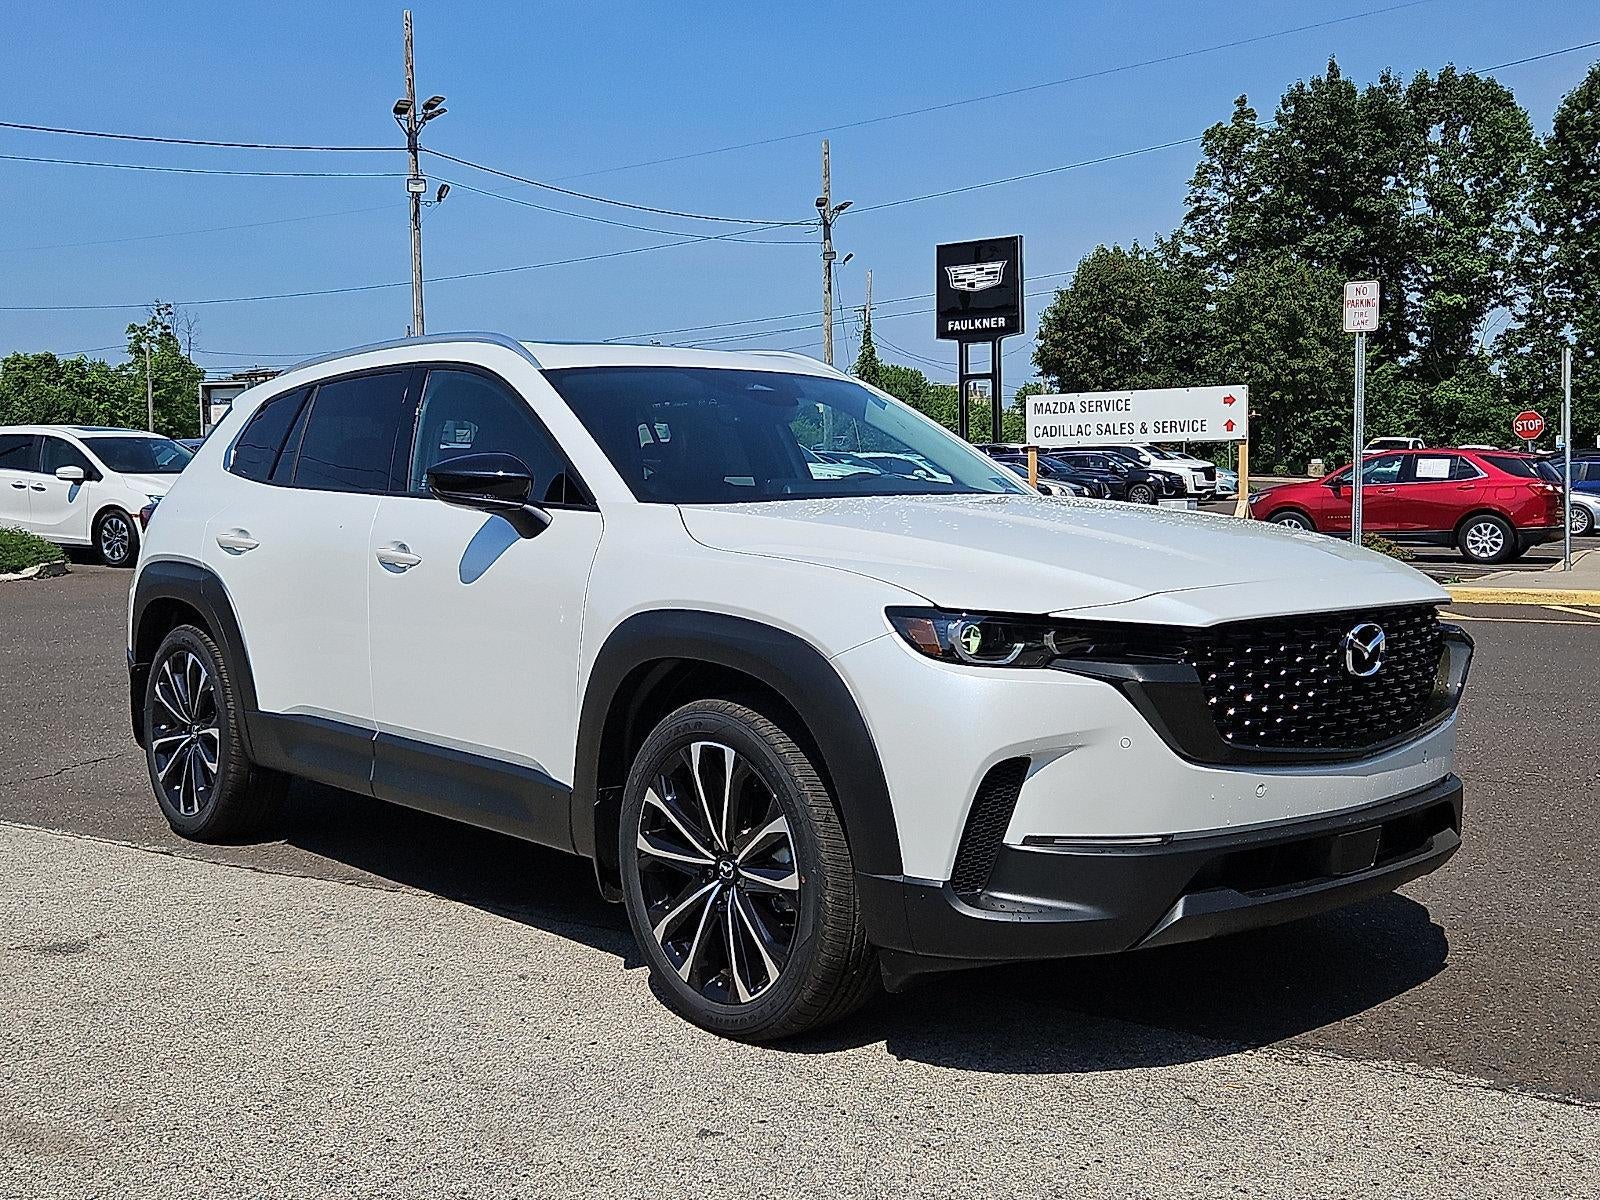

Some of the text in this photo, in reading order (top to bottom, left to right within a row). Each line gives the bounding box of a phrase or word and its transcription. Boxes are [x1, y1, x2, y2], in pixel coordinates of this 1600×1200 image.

[1355, 286, 1368, 296] NO
[1347, 298, 1376, 308] PARKING
[947, 317, 1006, 331] FAULKNER
[1033, 399, 1131, 415] MAZDA SERVICE
[1033, 419, 1208, 438] CADILLAC SALES & SERVICE
[1515, 419, 1542, 432] STOP
